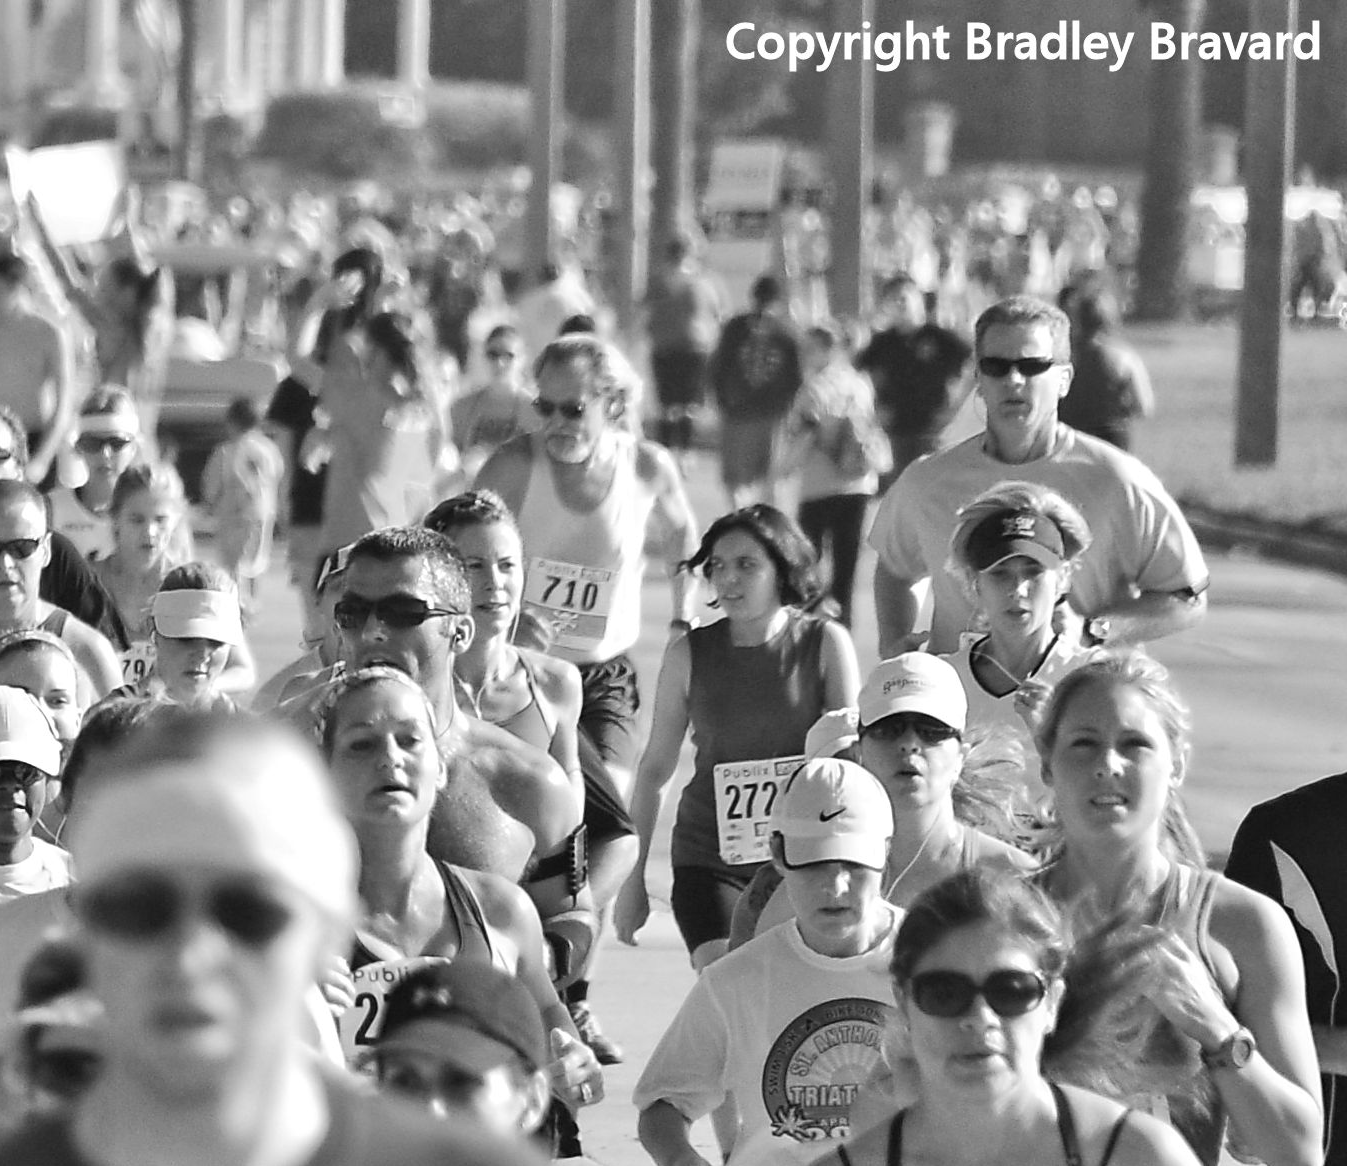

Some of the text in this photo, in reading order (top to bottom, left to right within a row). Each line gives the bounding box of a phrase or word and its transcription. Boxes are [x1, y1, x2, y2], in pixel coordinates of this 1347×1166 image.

[541, 576, 599, 612] 710
[789, 1025, 882, 1078] ST. ANTHO
[789, 1083, 860, 1107] TRIAT
